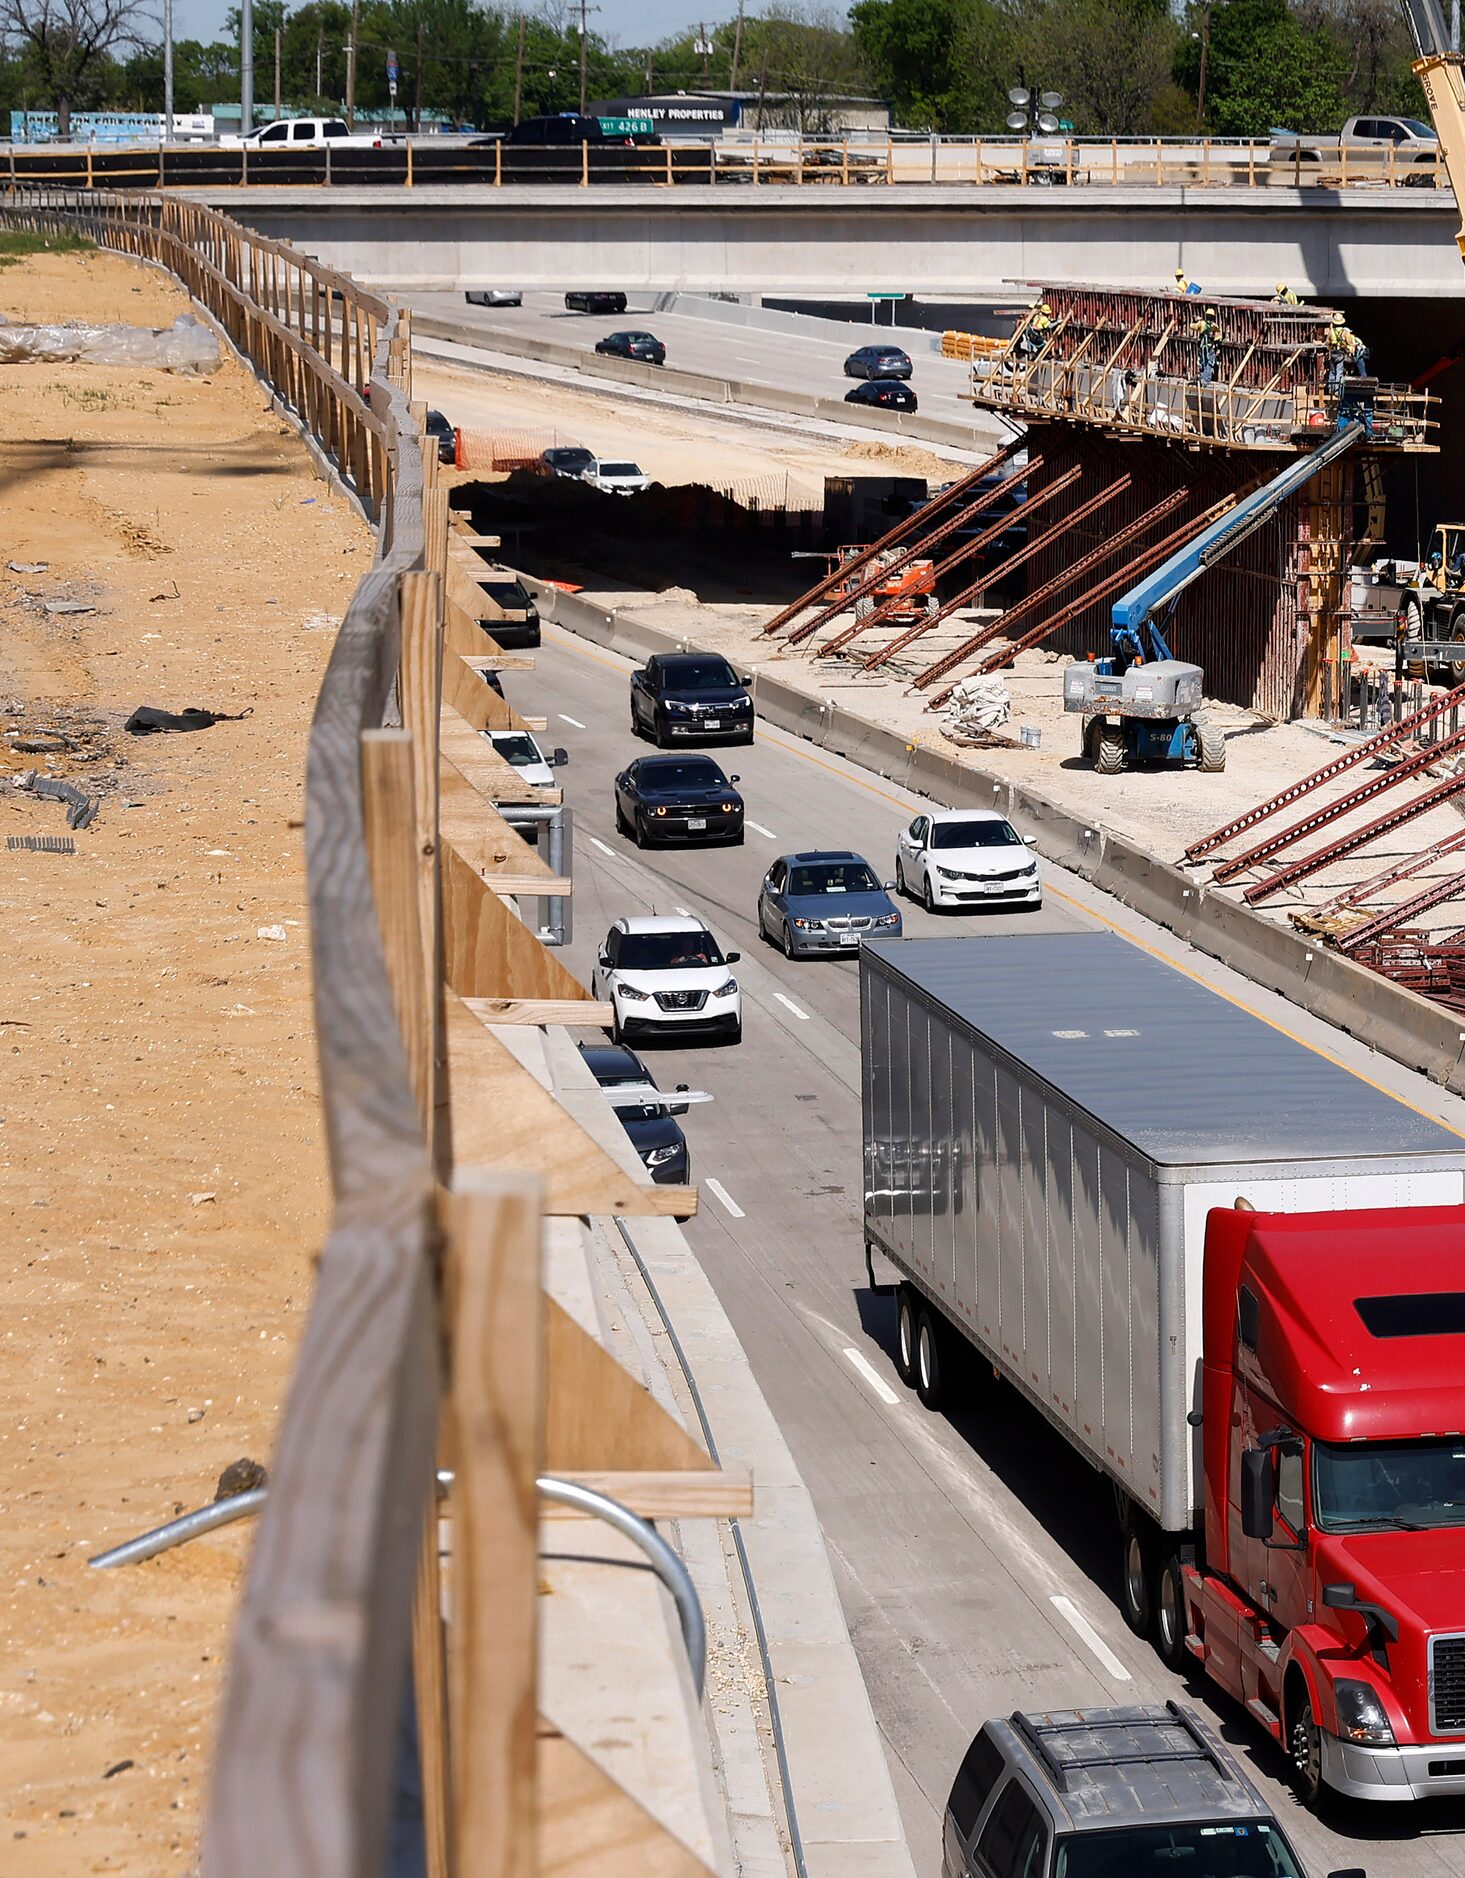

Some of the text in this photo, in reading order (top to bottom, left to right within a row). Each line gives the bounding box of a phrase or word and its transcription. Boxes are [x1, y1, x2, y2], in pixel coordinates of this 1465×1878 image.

[1422, 73, 1438, 110] GROVE
[627, 108, 725, 120] HENLEY PROPERTIES
[601, 122, 614, 130] XIT
[618, 121, 638, 132] 426
[1150, 733, 1172, 742] S-80
